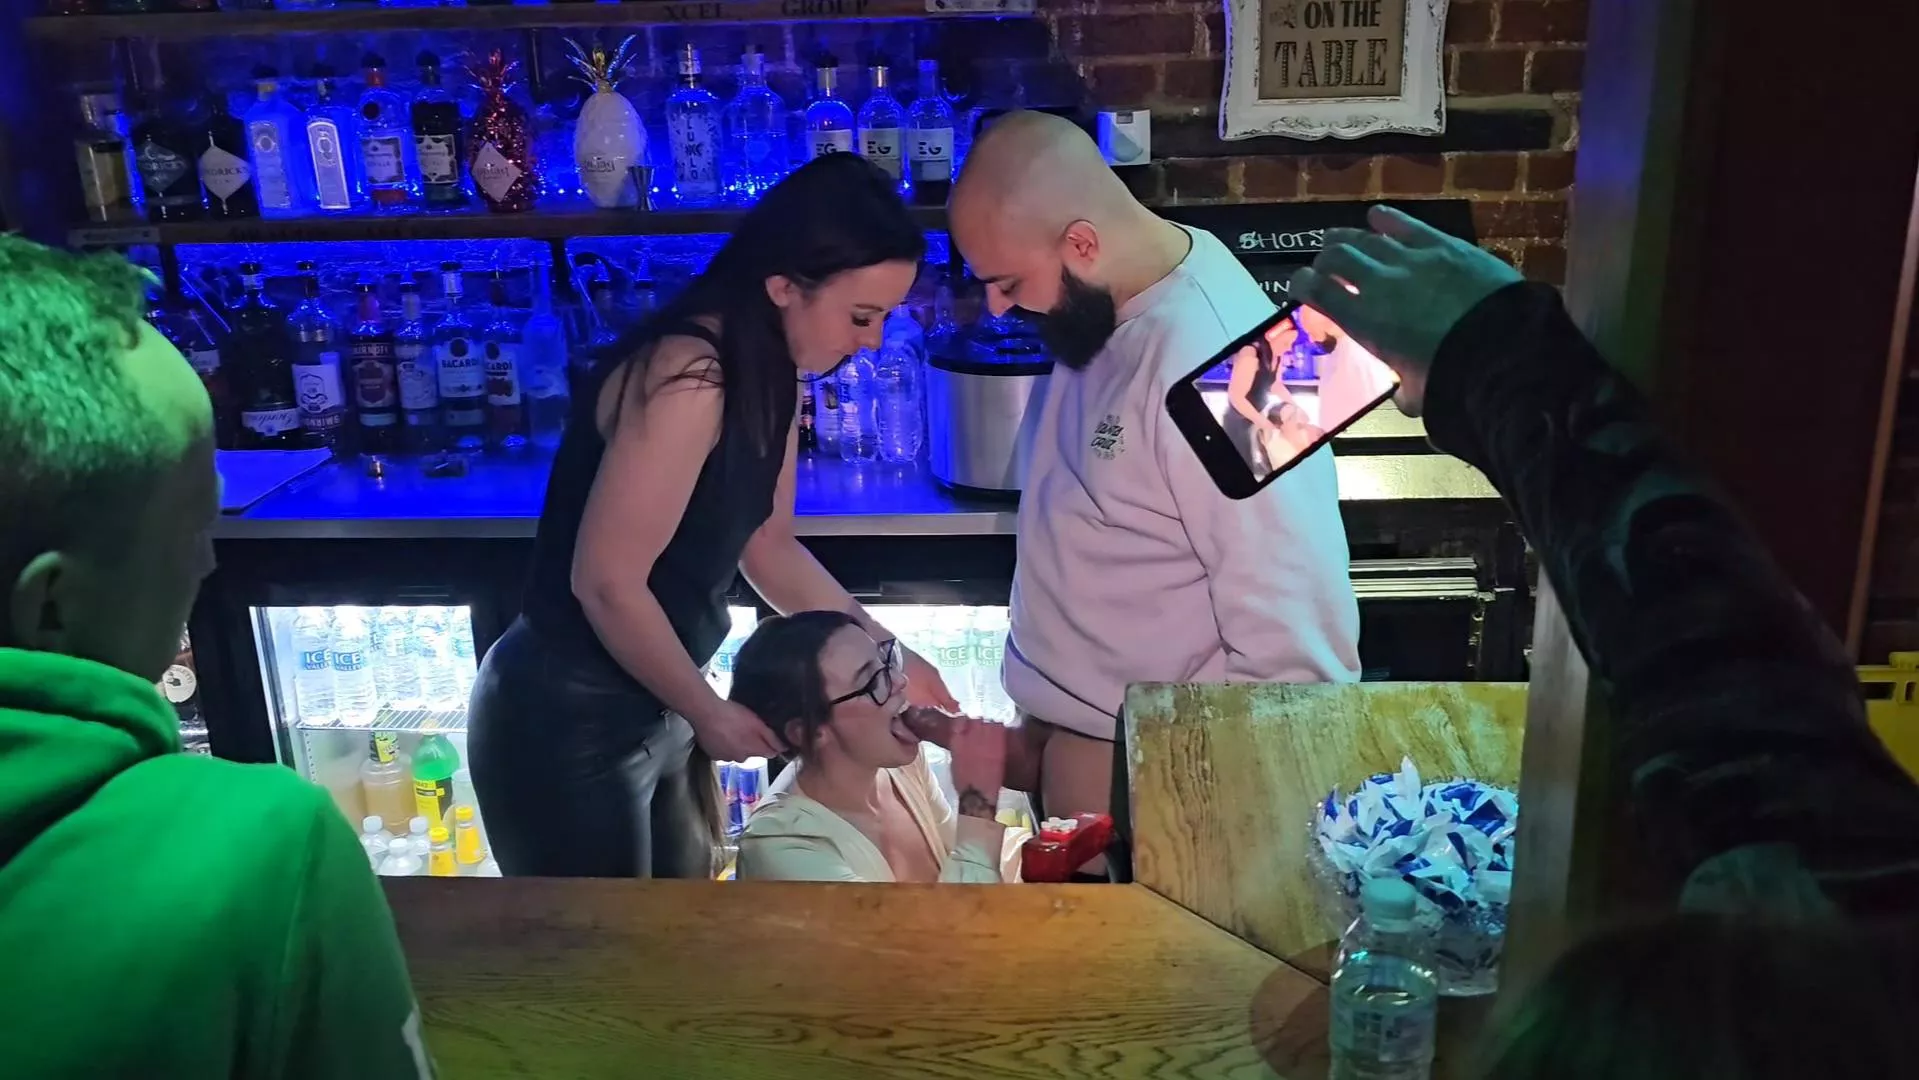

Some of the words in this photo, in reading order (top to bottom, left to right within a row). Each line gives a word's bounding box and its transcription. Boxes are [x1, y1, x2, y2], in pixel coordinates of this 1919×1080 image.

[781, 0, 869, 16] GROUP
[1303, 0, 1335, 29] ON
[1340, 0, 1381, 27] THE
[1273, 38, 1388, 88] TABLE
[867, 140, 892, 155] EG
[918, 141, 942, 155] EG
[1239, 229, 1324, 250] SHOTS
[305, 648, 331, 664] ICE
[334, 652, 361, 665] ICE
[940, 647, 967, 661] ICE
[977, 647, 1002, 661] ICE
